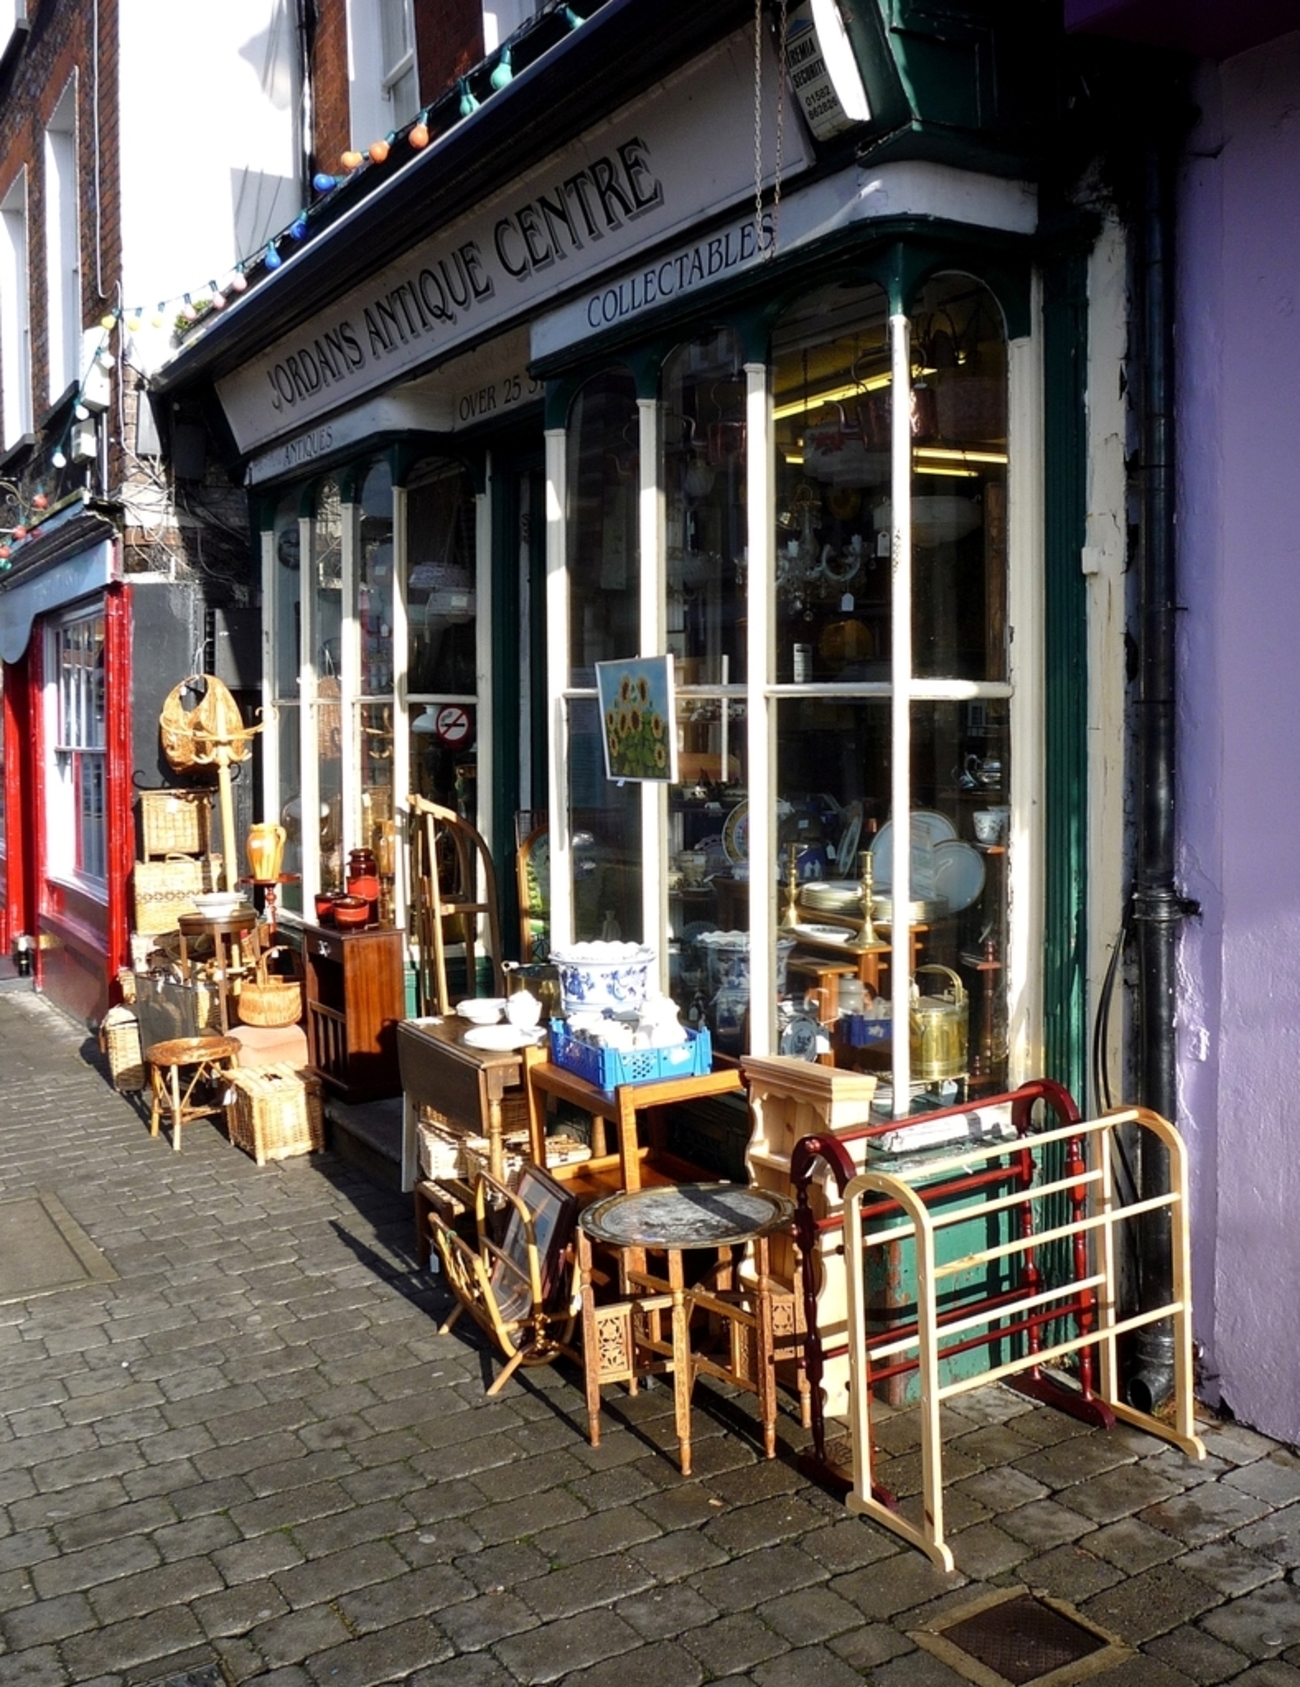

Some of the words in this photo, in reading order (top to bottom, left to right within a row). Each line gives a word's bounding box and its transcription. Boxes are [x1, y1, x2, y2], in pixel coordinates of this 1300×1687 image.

[269, 321, 364, 411] JORDANS
[366, 241, 495, 359] ANTIQUE
[493, 137, 664, 282] CENTRE
[587, 212, 775, 328] COLLECTABLES
[459, 385, 497, 421] OVER
[503, 375, 522, 404] 25
[283, 425, 334, 467] ANTIQUES
